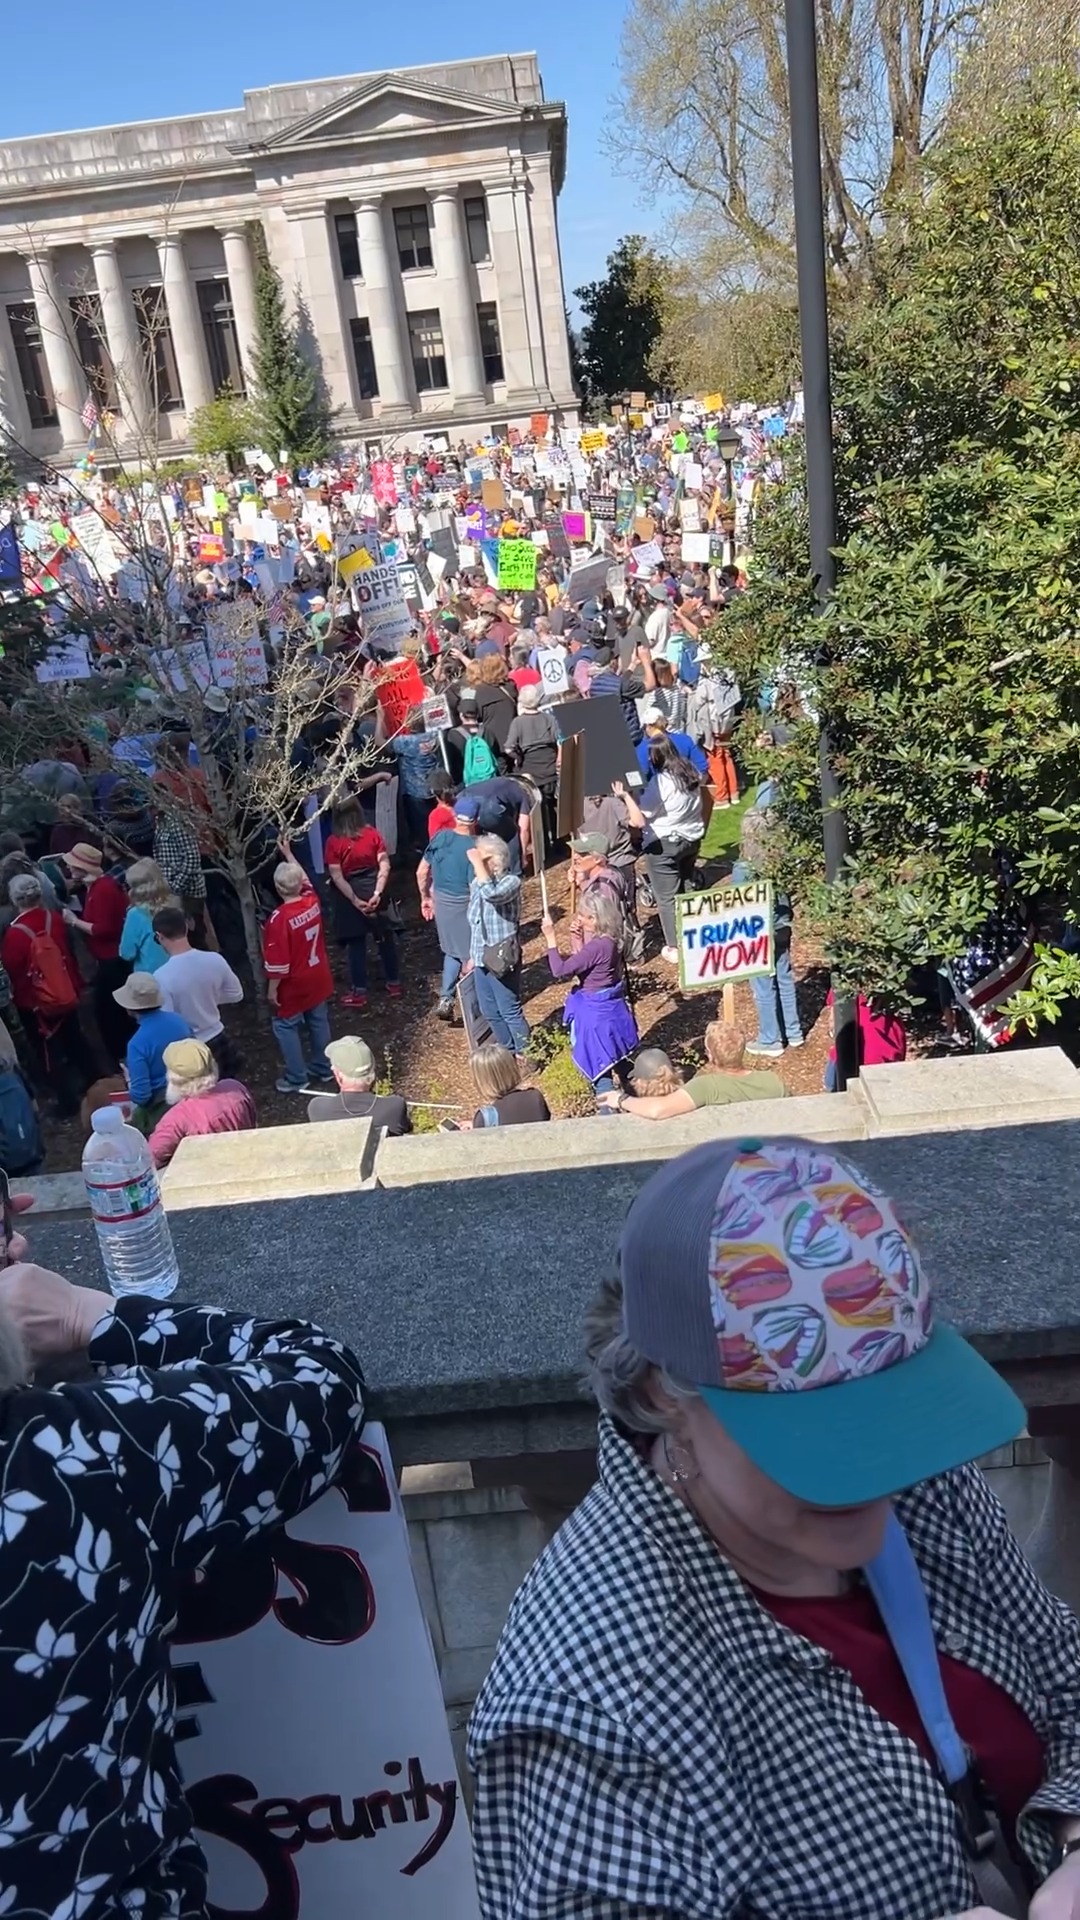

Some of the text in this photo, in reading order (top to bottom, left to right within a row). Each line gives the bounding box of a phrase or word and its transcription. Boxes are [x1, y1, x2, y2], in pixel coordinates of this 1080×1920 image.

[354, 565, 397, 585] HANDS
[358, 578, 399, 602] OFF!
[682, 883, 767, 917] IMPEACH
[304, 923, 320, 967] 7
[683, 915, 766, 950] TRUMP
[698, 935, 769, 978] NOW!
[184, 1757, 457, 1920] Security
